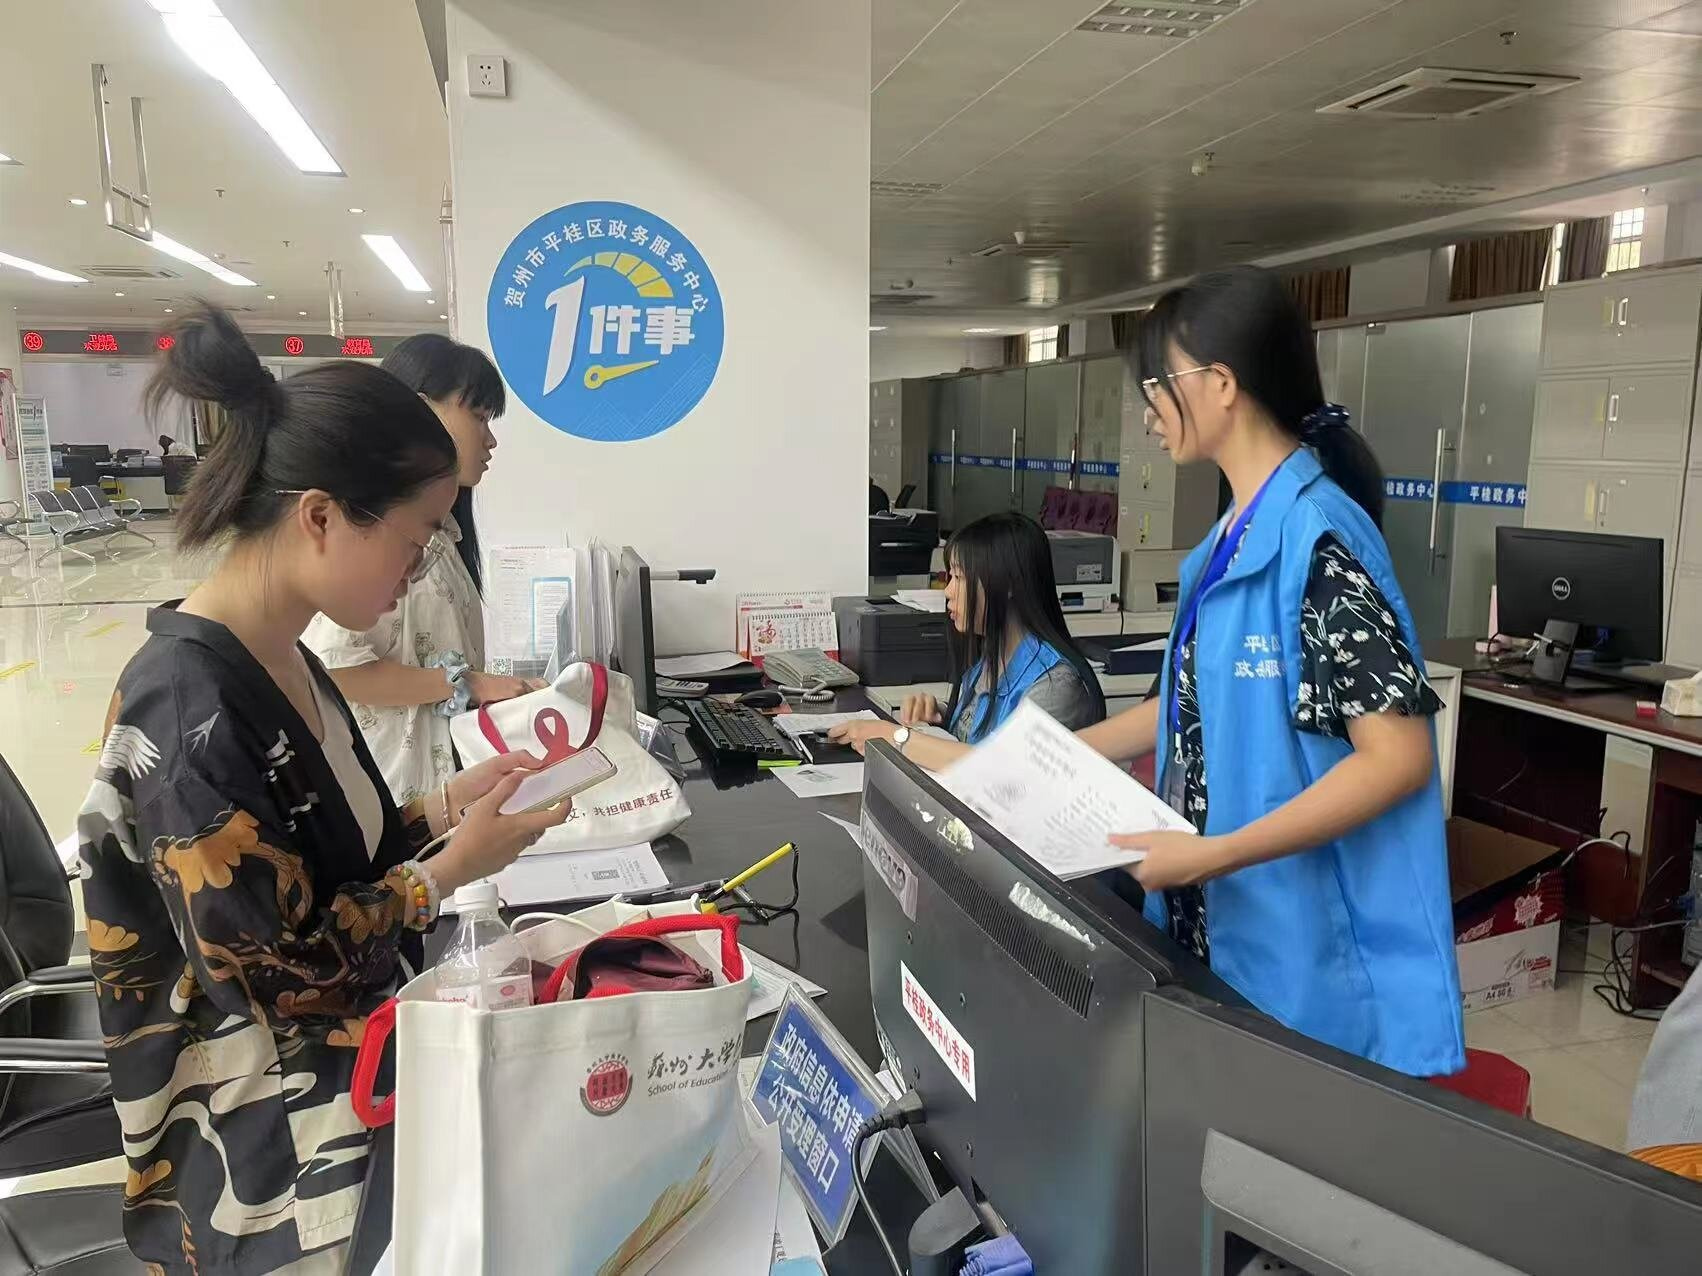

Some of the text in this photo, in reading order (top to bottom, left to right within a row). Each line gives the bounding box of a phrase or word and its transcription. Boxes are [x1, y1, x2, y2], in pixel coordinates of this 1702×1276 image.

[504, 218, 709, 313] 贺州市平桂区政务服务中心
[26, 336, 41, 348] 39
[288, 339, 300, 352] 37
[904, 975, 970, 1083] 平桂政务中心专用
[648, 1081, 676, 1097] School
[679, 1080, 690, 1089] of
[768, 1074, 840, 1195] 公开受理窗口
[775, 1023, 864, 1153] 政府信息依申请
